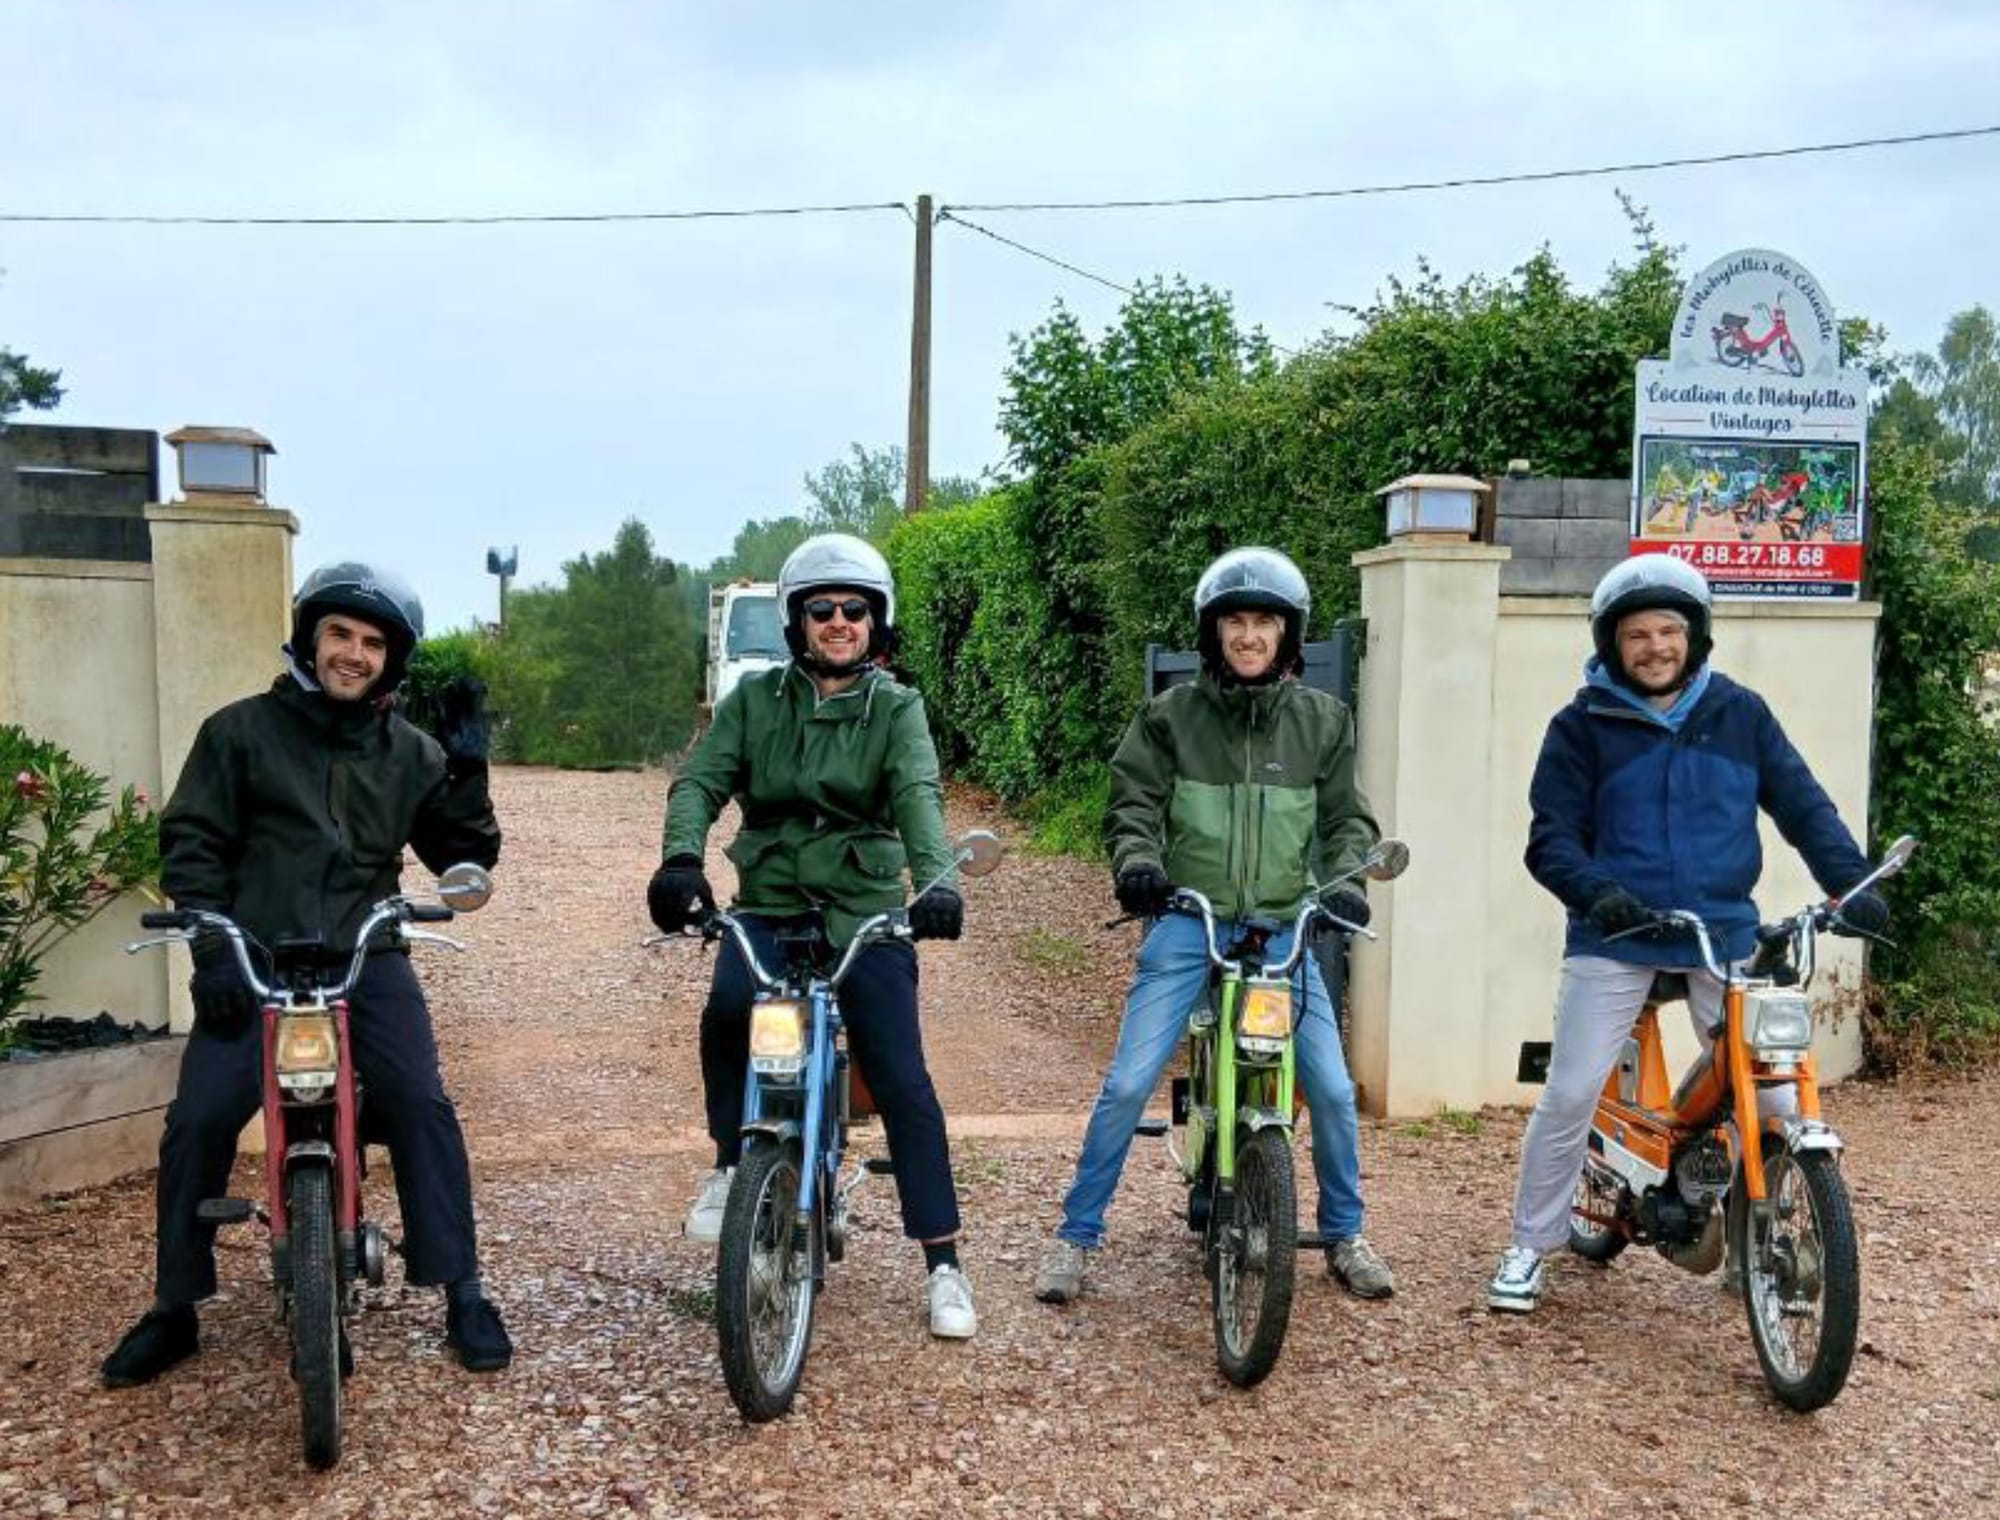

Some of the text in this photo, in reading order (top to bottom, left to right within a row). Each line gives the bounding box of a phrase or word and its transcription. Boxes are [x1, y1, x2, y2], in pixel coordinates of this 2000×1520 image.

[1690, 256, 1769, 311] Mobylettes
[1772, 261, 1793, 281] de
[1646, 381, 1856, 414] Location de Mobylettes
[1709, 410, 1791, 437] Vintages
[1667, 543, 1824, 567] 07.88.27.18.68
